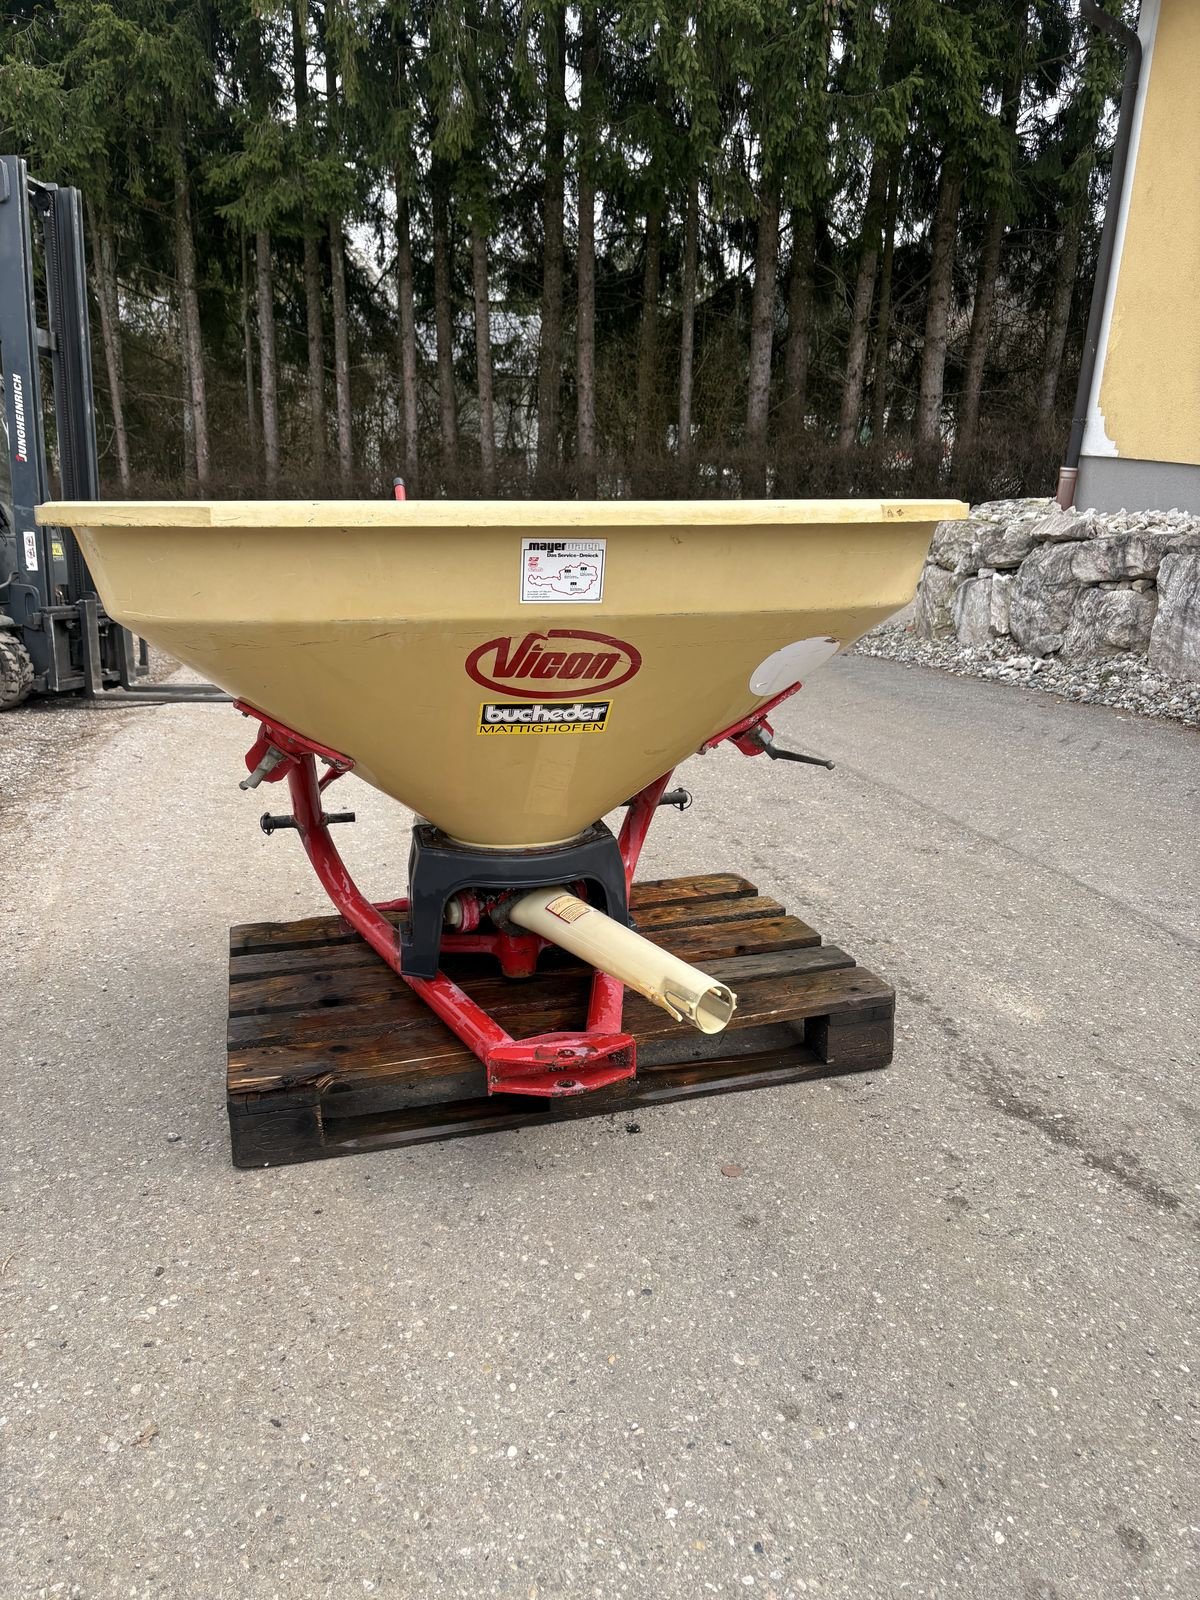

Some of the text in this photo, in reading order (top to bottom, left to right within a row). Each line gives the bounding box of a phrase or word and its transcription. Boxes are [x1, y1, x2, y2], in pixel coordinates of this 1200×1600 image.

[12, 373, 28, 462] JUNGHEINRICH
[493, 633, 621, 679] Vicon
[479, 723, 605, 733] MATTIGHOFEN
[485, 704, 607, 723] bucheder
